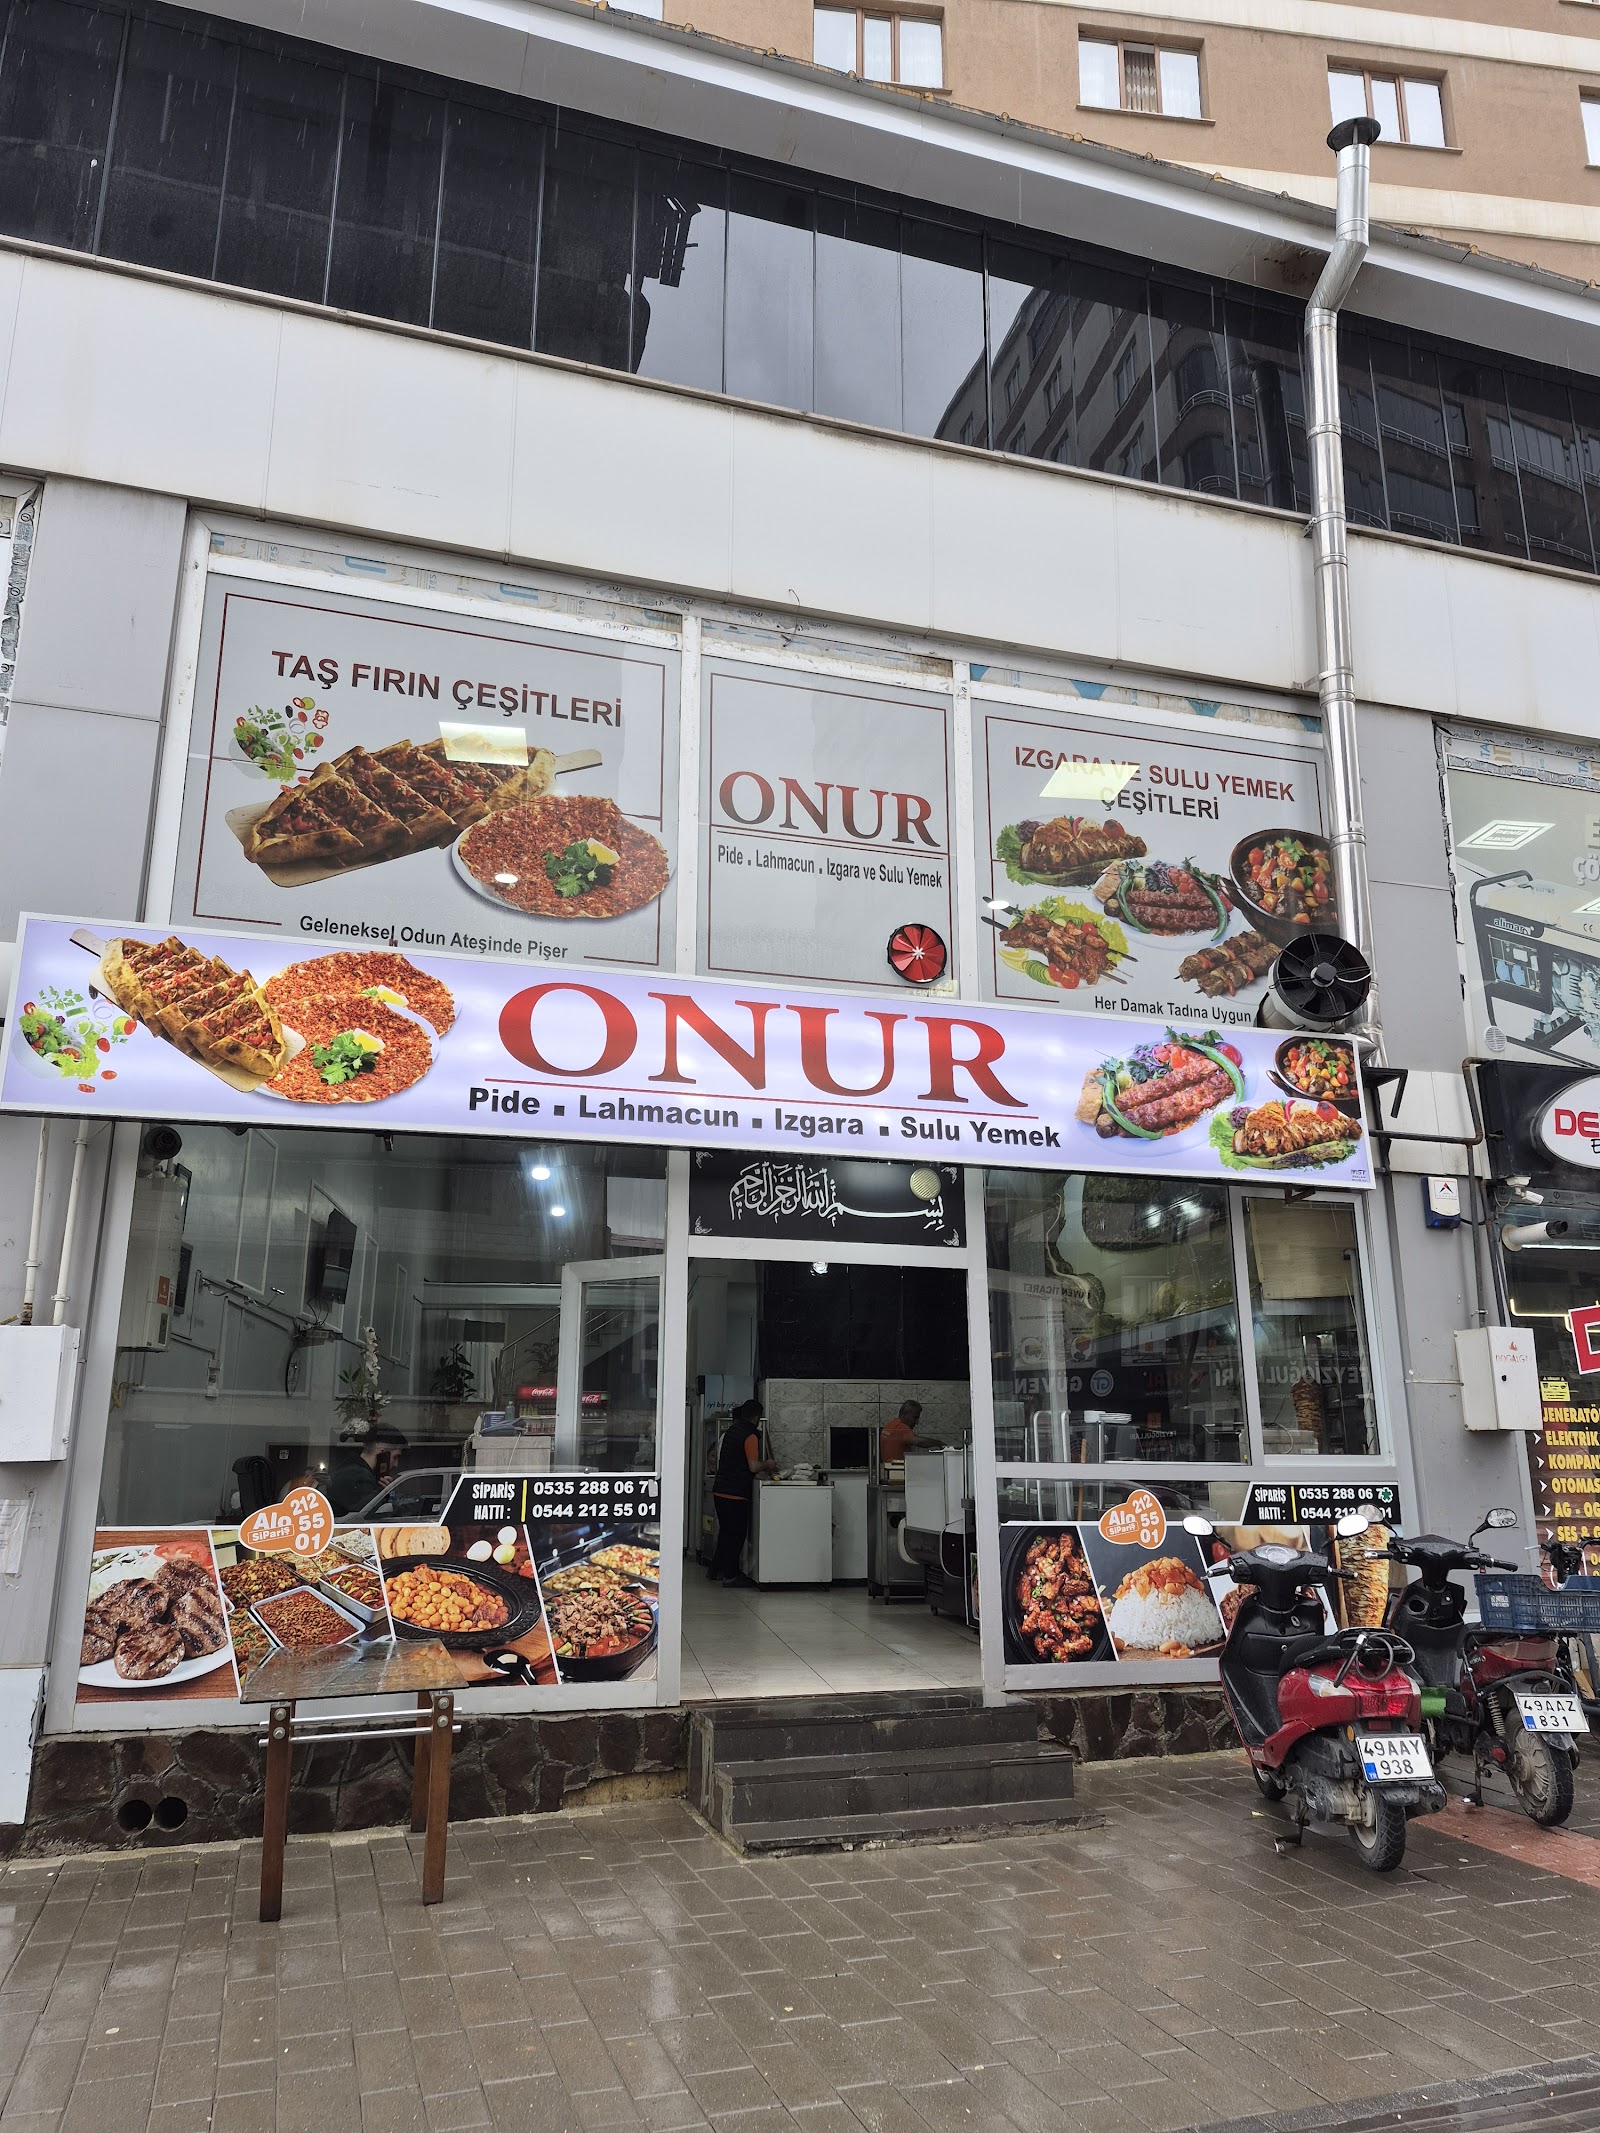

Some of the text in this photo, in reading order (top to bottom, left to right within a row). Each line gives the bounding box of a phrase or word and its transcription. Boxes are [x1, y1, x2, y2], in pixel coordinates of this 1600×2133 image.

[271, 650, 622, 728] TAŞ FIRIN ÇEŞİTLERİ
[1015, 746, 1296, 802] IZGARA VE SULU YEMEK
[719, 771, 941, 847] ONUR
[1100, 786, 1220, 820] ÇEŞİTLERİ
[718, 844, 943, 888] Pide Lahmacun Izgara ve Sulu Yemek
[300, 915, 569, 961] Geleneksel Odun Ateşinde Pişer
[1095, 996, 1252, 1025] Her Damak Tadına Uygun
[499, 982, 1029, 1108] ONUR
[469, 1087, 1062, 1148] Pide Lahmacun Izgara Sulu Yemek
[1543, 1404, 1600, 1423] JENERATÖ
[1545, 1427, 1600, 1446] ELEKTRİK
[472, 1481, 515, 1500] SİPARİŞ
[533, 1481, 574, 1495] 0535
[579, 1481, 609, 1494] 288
[614, 1481, 634, 1494] 06
[1254, 1487, 1287, 1504] SİPARİŞ
[1299, 1488, 1329, 1500] 0535
[1332, 1488, 1355, 1500] 288
[1358, 1488, 1373, 1500] 06
[290, 1493, 319, 1516] 212
[532, 1503, 657, 1518] 0544 212 55 01
[1132, 1494, 1153, 1514] 212
[1301, 1507, 1331, 1519] 0544
[1555, 1502, 1571, 1517] AG
[253, 1511, 292, 1530] Alo
[299, 1512, 325, 1531] 55
[1108, 1510, 1136, 1526] Alo
[1140, 1511, 1159, 1528] 55
[295, 1533, 320, 1550] 01
[1140, 1528, 1159, 1543] 01
[1557, 1526, 1578, 1541] SES
[1539, 1715, 1570, 1727] 831
[1380, 1759, 1414, 1776] 938
